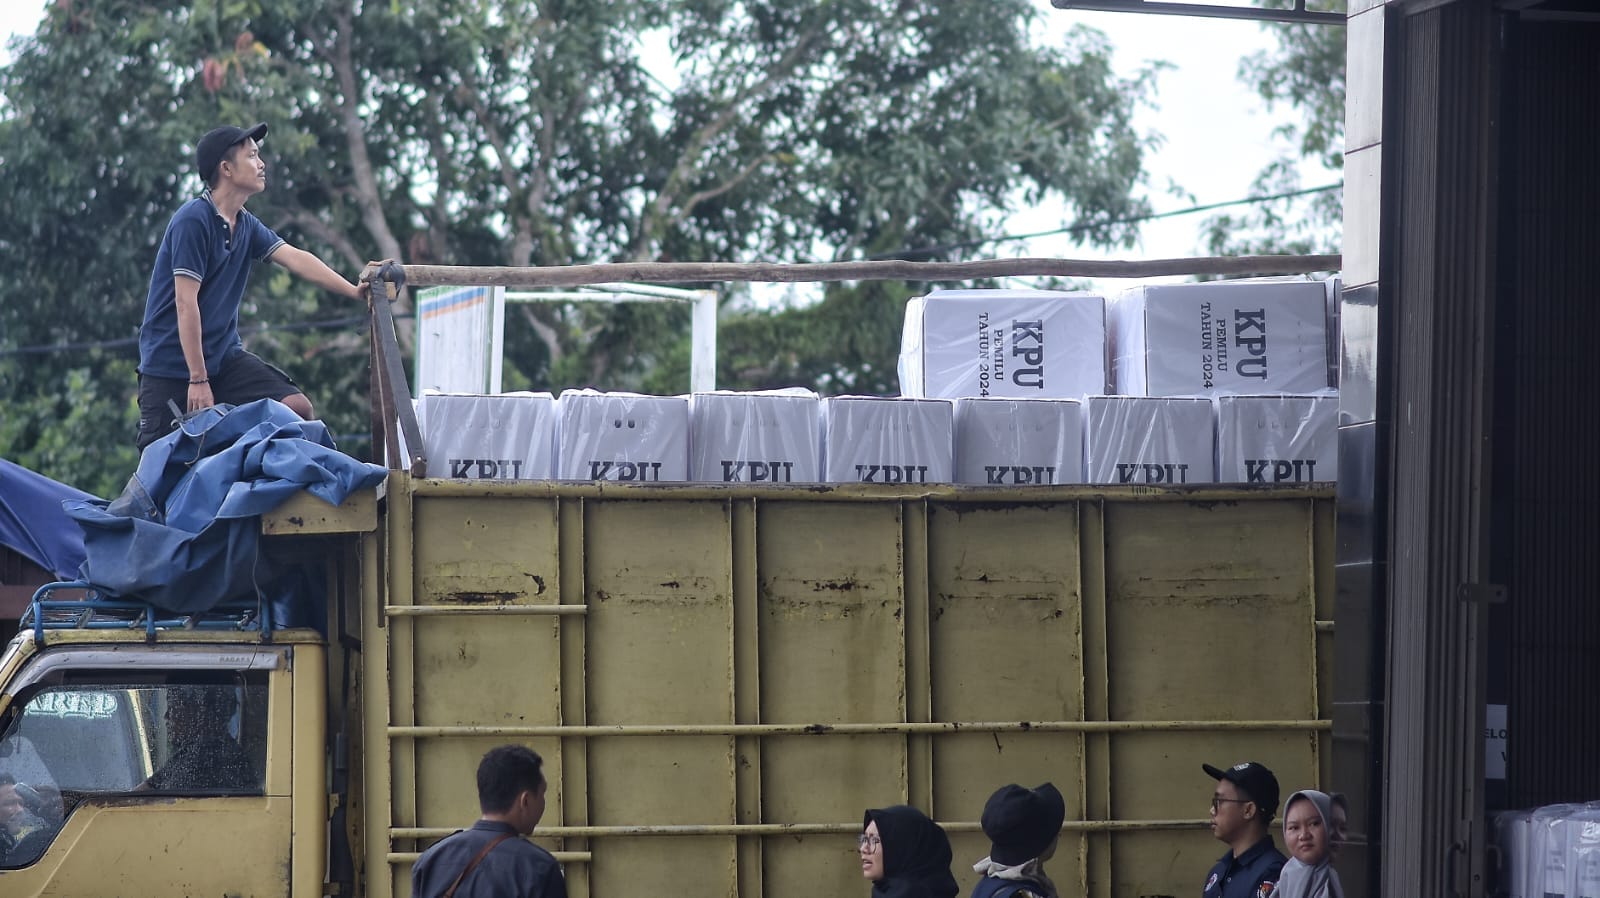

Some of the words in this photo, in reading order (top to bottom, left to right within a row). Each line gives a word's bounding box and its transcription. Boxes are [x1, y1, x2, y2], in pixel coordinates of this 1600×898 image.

[978, 312, 990, 359] TAHUN
[1201, 302, 1212, 350] TAHUN
[1216, 318, 1228, 372] PEMILU
[1234, 308, 1267, 380] KPU
[994, 329, 1004, 381] PEMILU
[1012, 319, 1044, 389] KPU
[1202, 355, 1213, 389] 2024
[979, 364, 990, 398] 2024
[1244, 459, 1317, 482] KPU
